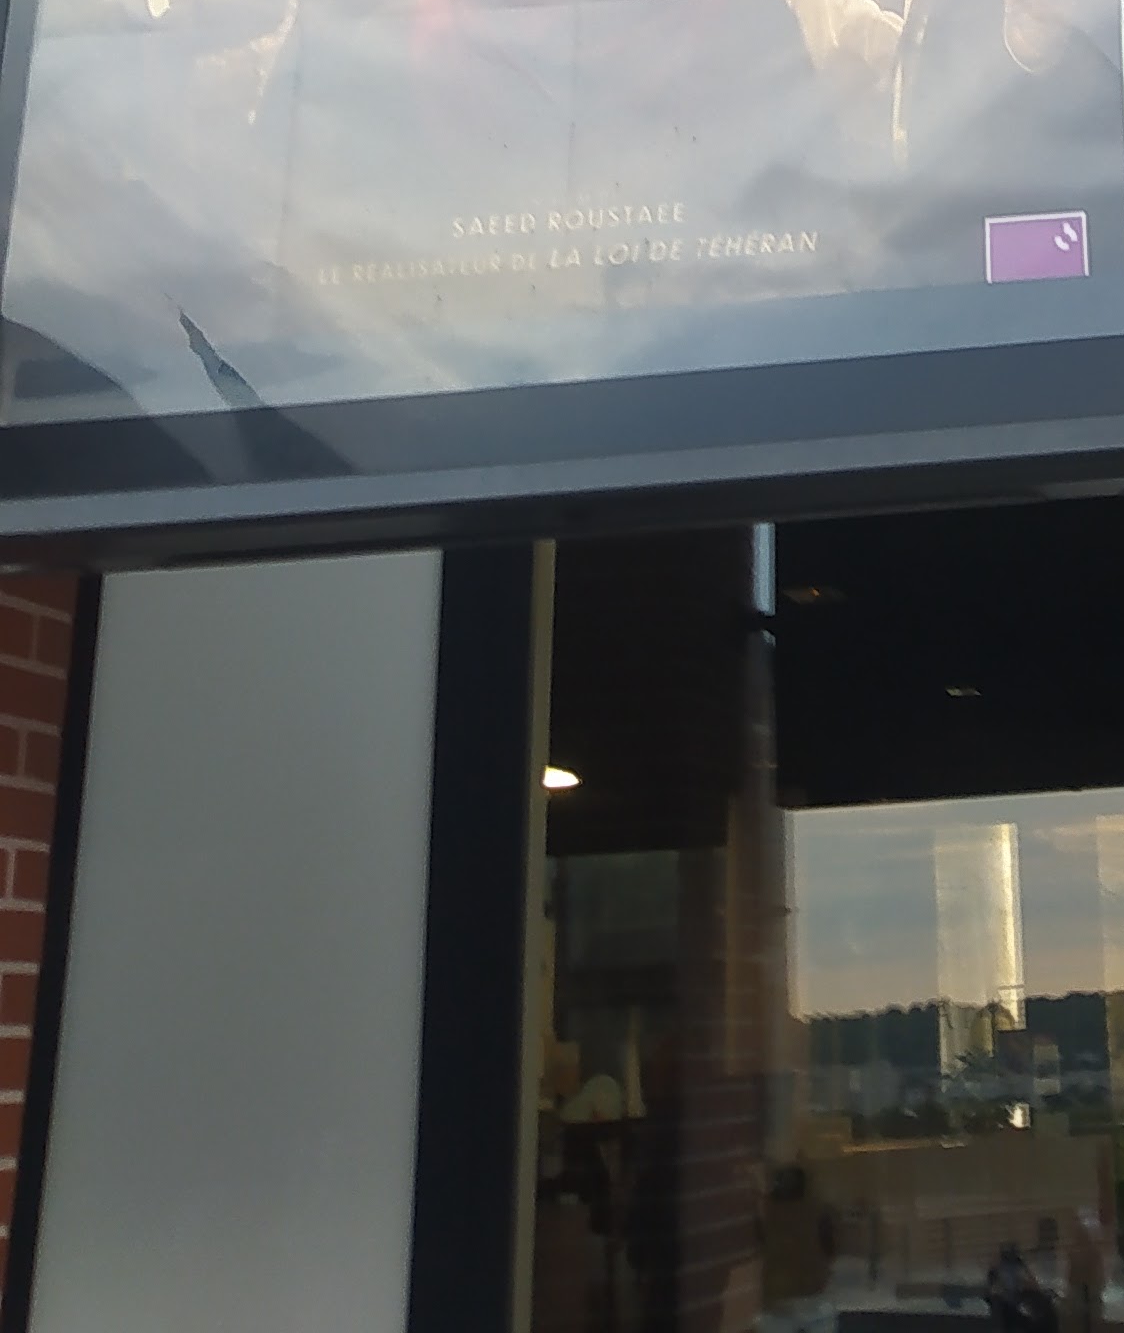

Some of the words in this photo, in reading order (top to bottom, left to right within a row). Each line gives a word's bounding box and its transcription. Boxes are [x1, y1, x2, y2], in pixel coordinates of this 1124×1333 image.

[452, 211, 536, 238] SAEED
[549, 247, 581, 268] LA
[593, 243, 640, 266] LOI
[649, 238, 684, 262] DE
